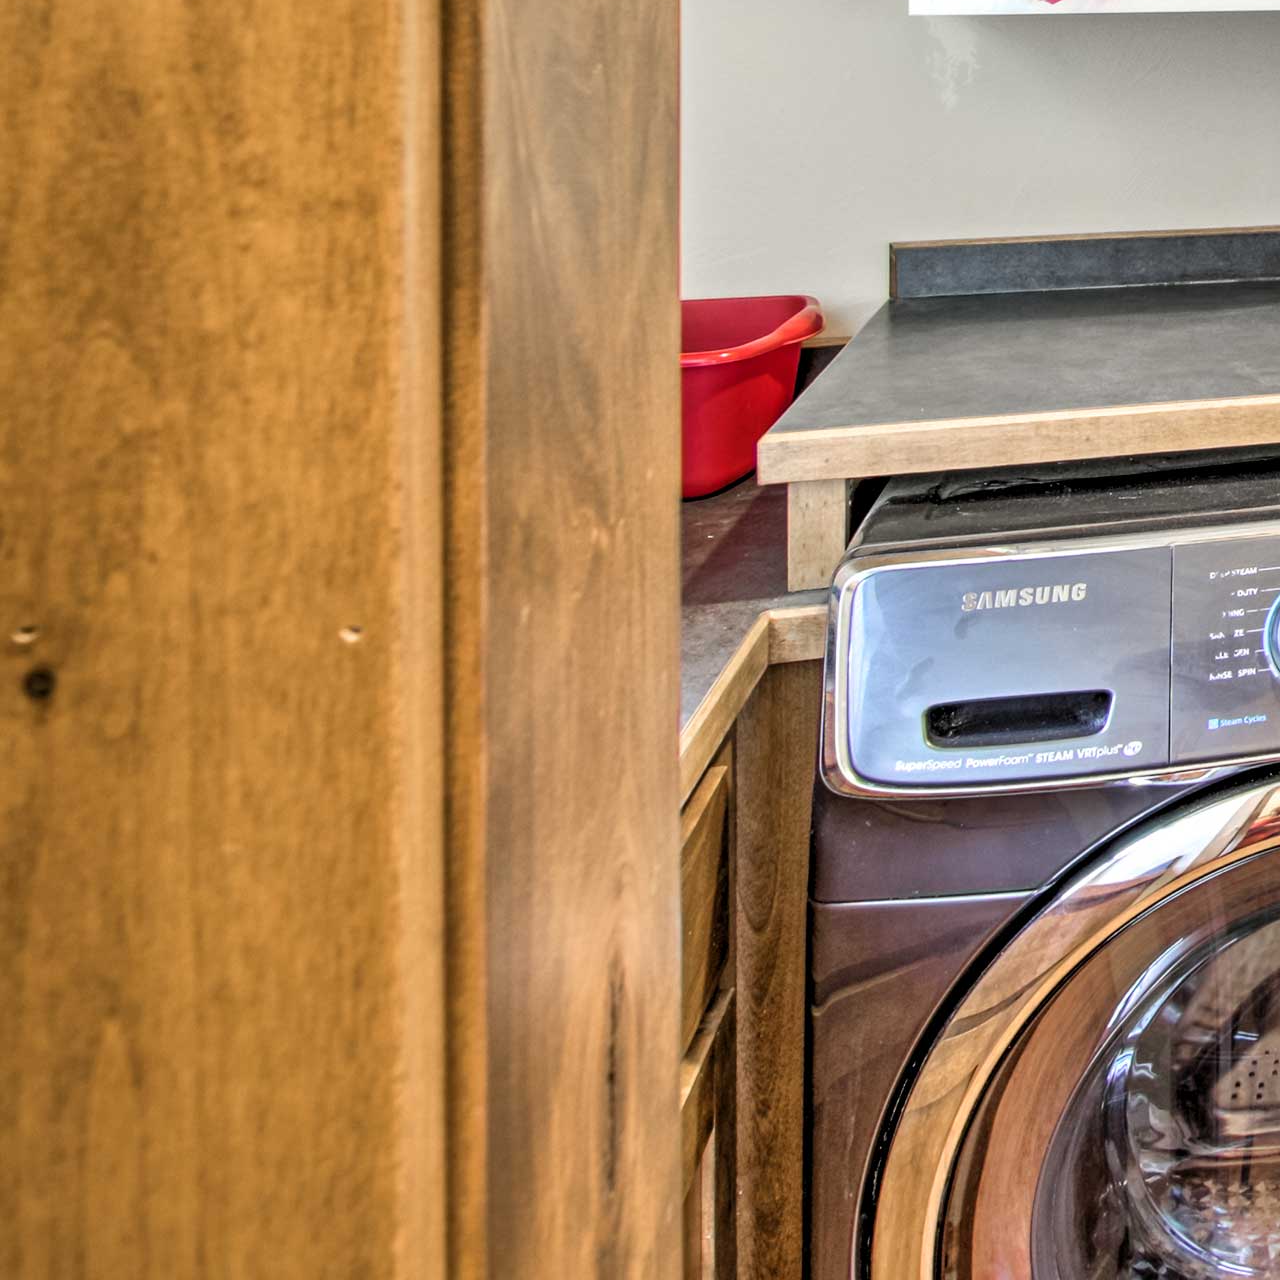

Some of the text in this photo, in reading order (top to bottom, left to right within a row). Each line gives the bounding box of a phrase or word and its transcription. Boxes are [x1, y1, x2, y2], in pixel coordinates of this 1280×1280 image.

[961, 582, 1088, 612] SAMSUNG
[1238, 668, 1256, 677] SPIN
[1220, 714, 1266, 727] Steam Cycles
[895, 758, 962, 771] SuperSpeed
[1035, 750, 1074, 764] STEAM
